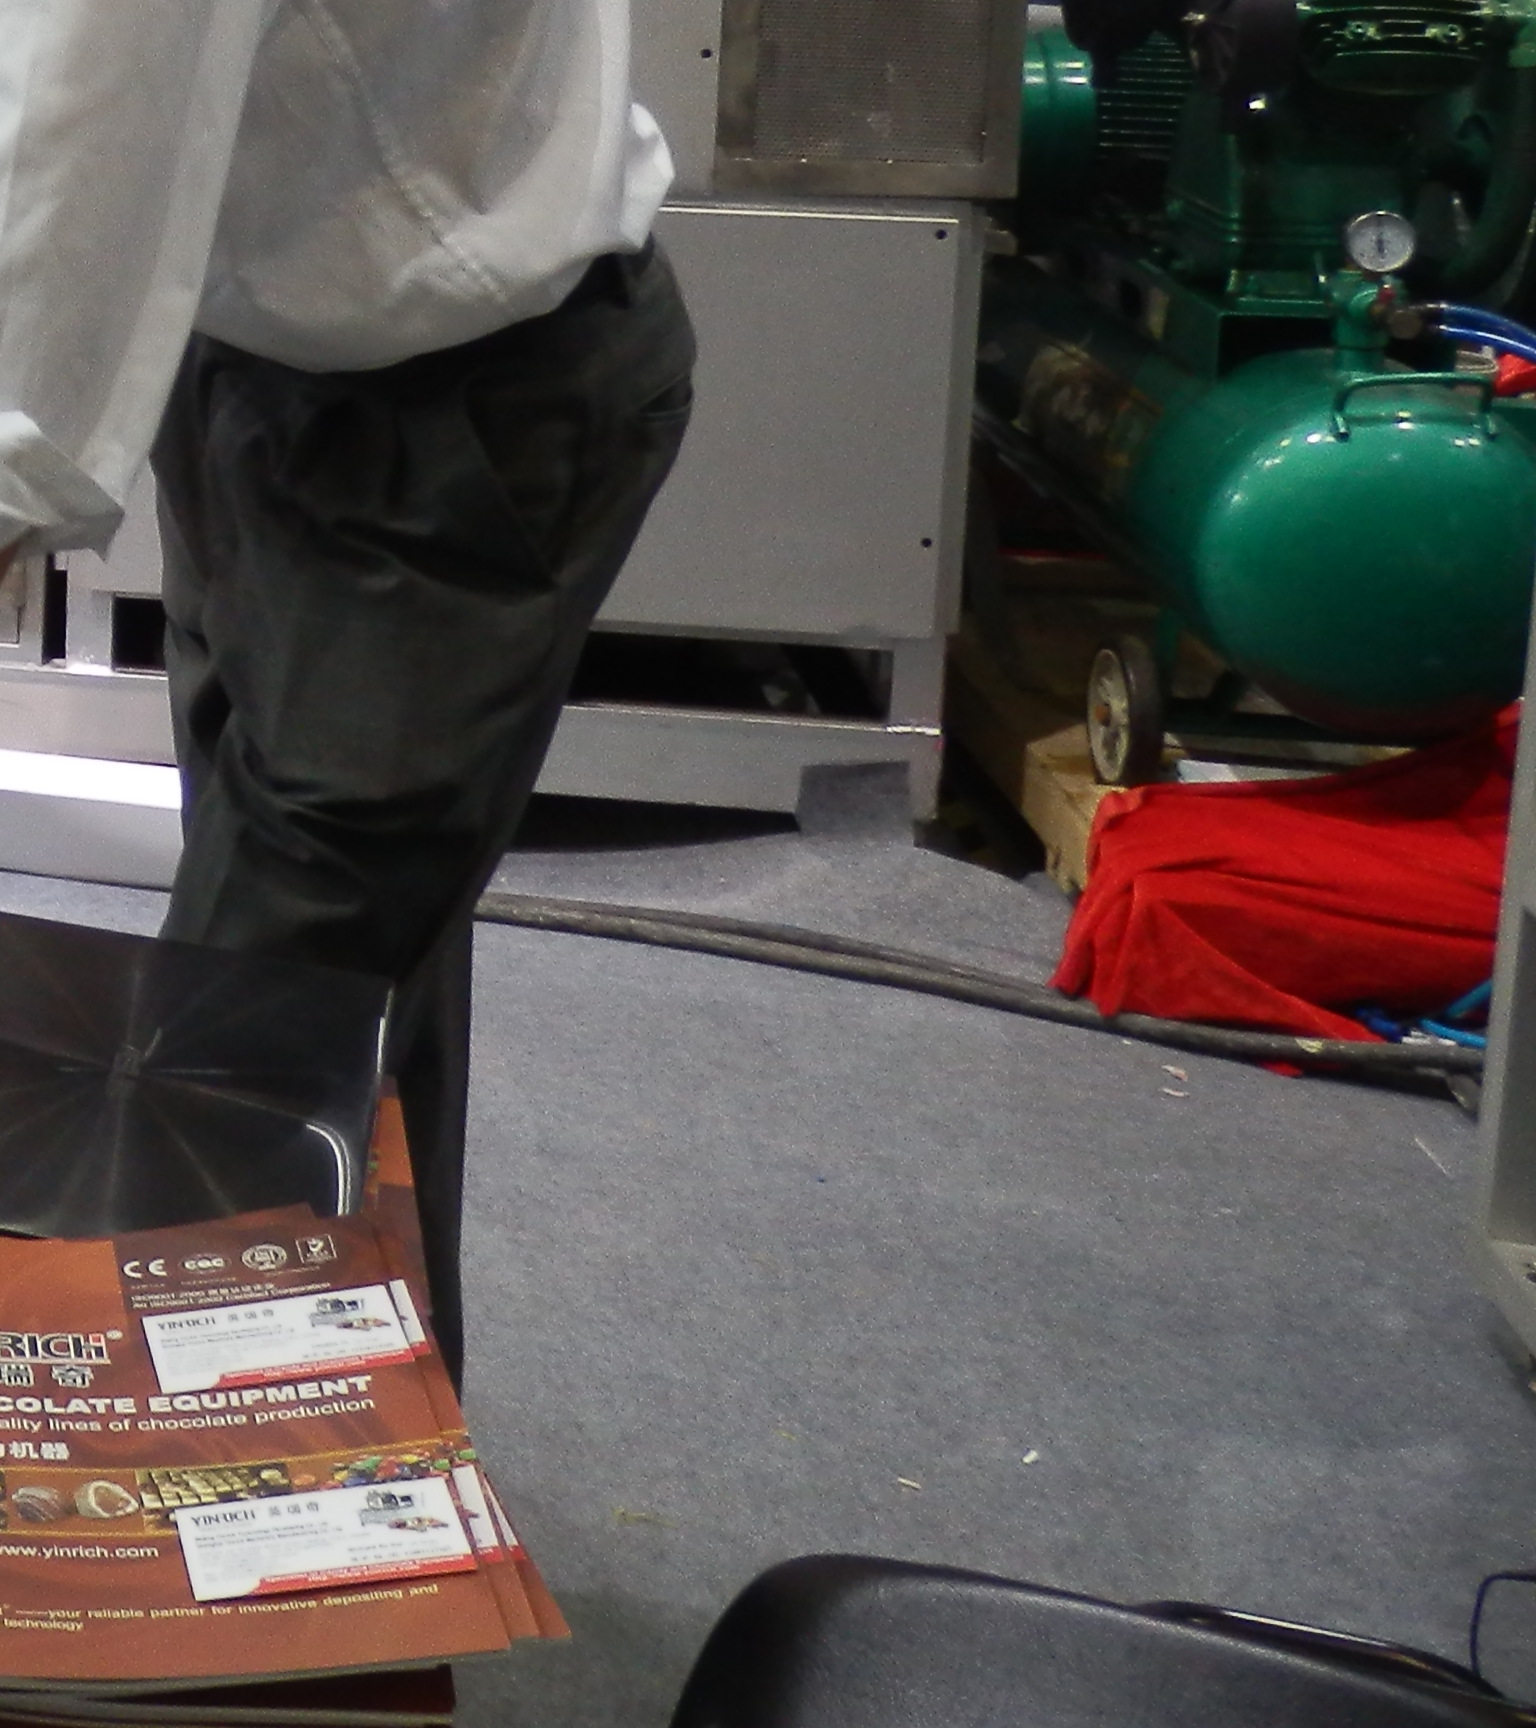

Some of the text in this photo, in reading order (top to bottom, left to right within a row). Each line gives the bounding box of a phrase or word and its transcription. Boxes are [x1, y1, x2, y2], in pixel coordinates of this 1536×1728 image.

[149, 1375, 373, 1413] EQUIPMENT
[48, 1416, 101, 1432] lines
[108, 1416, 132, 1432] of
[138, 1412, 245, 1432] chocolate
[255, 1396, 376, 1427] production
[88, 1607, 145, 1619] reliable
[151, 1605, 206, 1620] partner
[212, 1604, 232, 1614] for
[239, 1599, 318, 1614] innovative
[323, 1589, 403, 1609] depositing
[410, 1583, 439, 1598] and
[4, 1618, 84, 1632] technology
